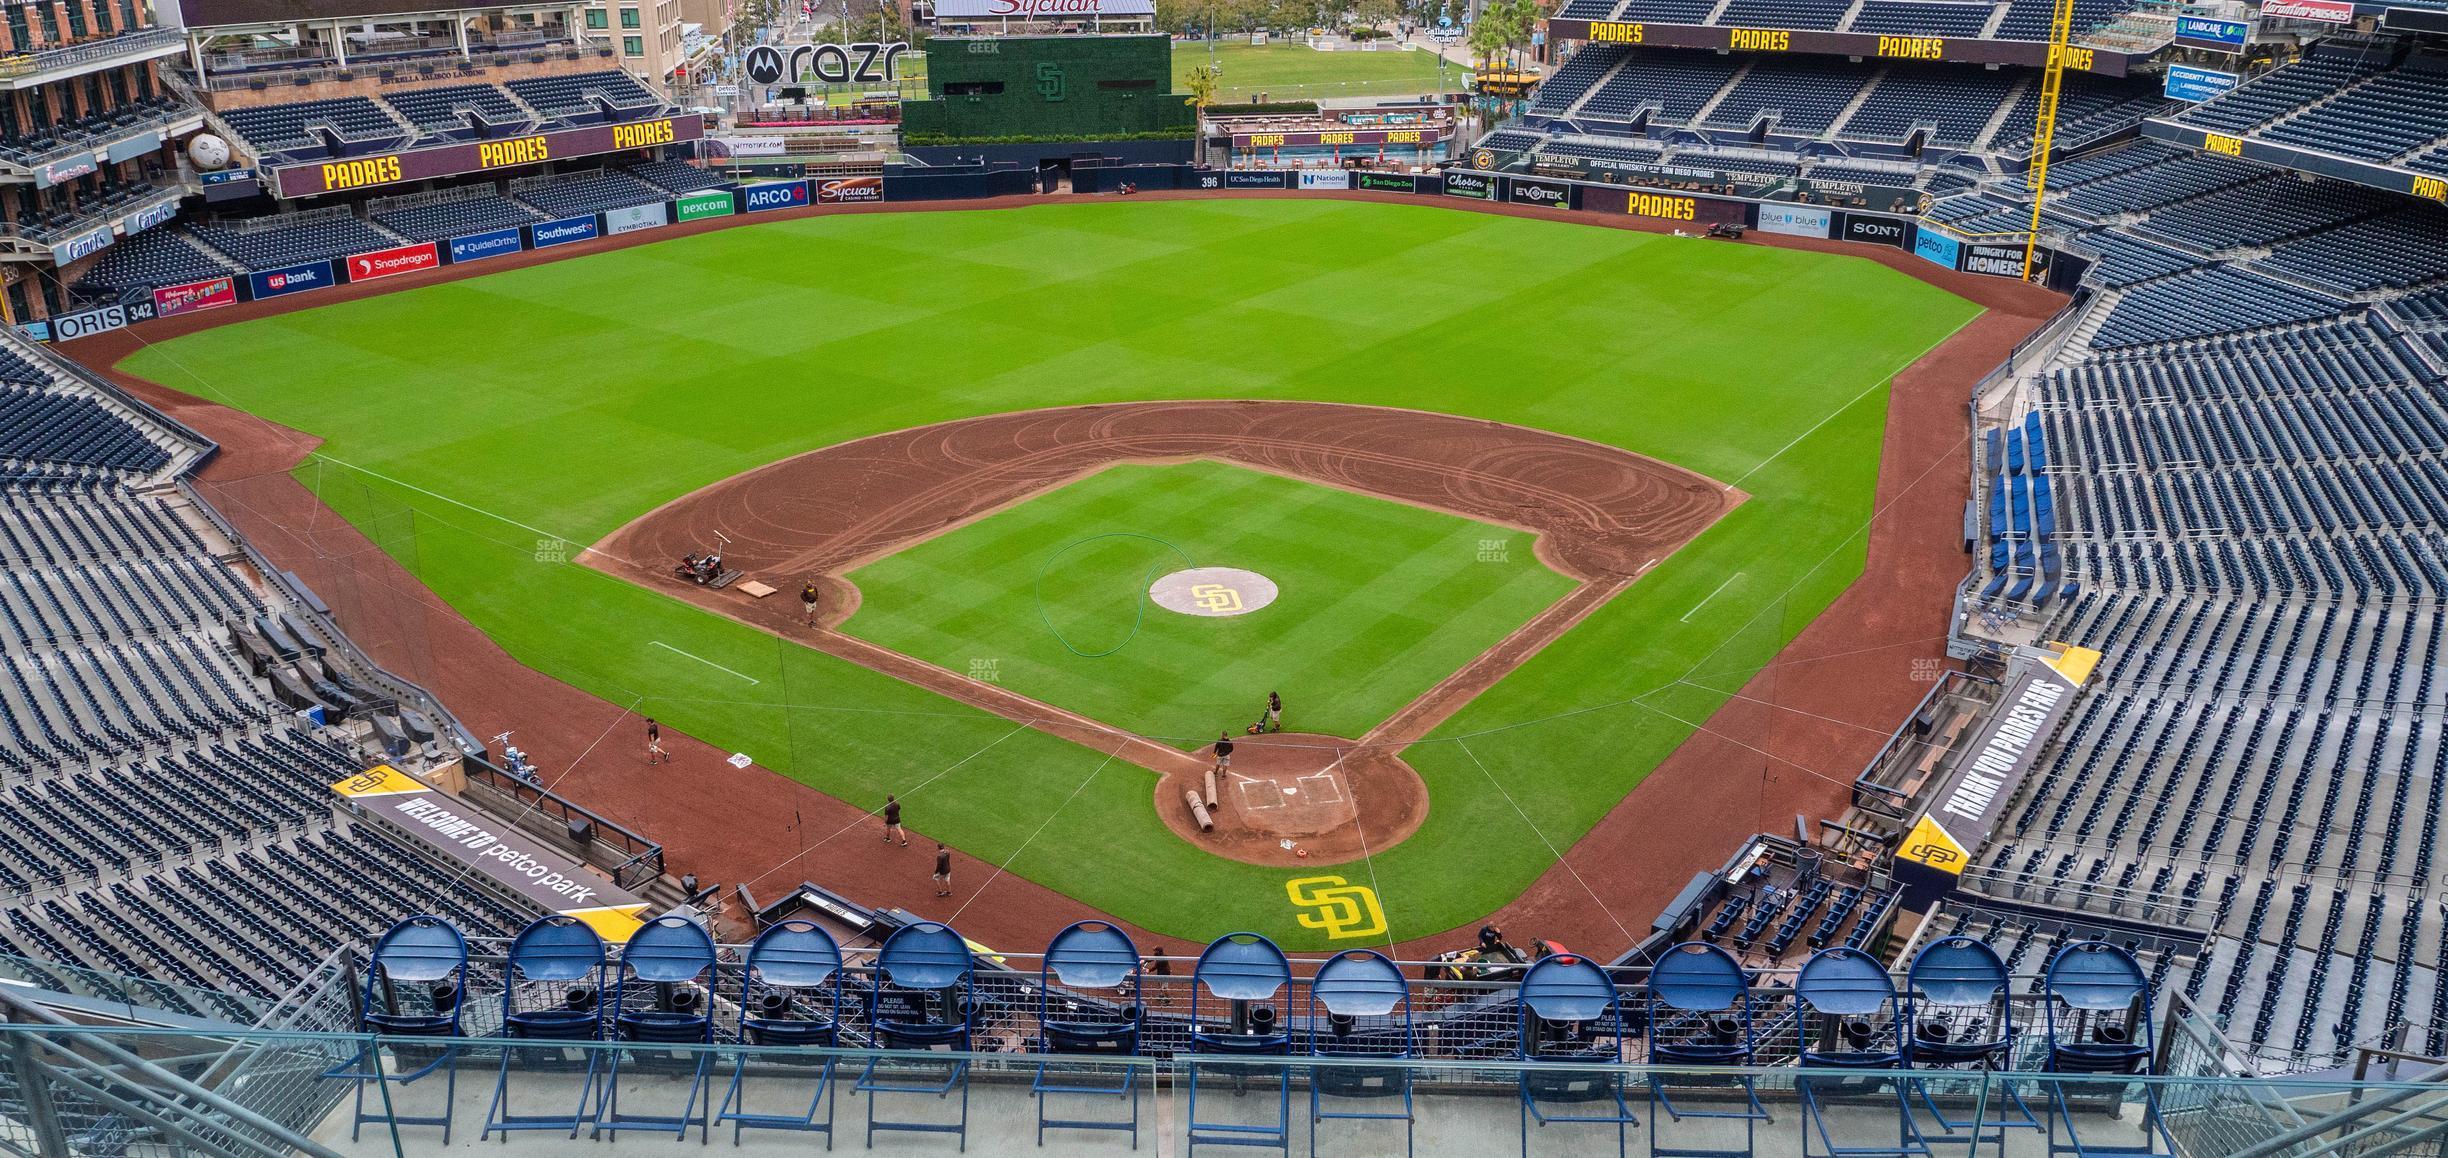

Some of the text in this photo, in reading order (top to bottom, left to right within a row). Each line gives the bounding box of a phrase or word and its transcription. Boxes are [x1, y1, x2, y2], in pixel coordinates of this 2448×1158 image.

[2263, 0, 2350, 21] Tarantino SAUSAGES
[1424, 27, 1463, 38] Gallagher
[1590, 21, 1643, 43] PADRES
[2188, 20, 2224, 38] LANDCARE
[1429, 35, 1457, 43] Square
[1730, 28, 1790, 51] PADRES
[1877, 36, 1943, 59] PADRES
[788, 42, 909, 84] razr
[2048, 44, 2094, 71] PDRES
[611, 119, 674, 149] PADRES
[1250, 134, 1285, 146] PADRES
[1320, 133, 1354, 144] PADRES
[1387, 131, 1421, 142] PADRES
[479, 136, 549, 168] PADRES
[2204, 133, 2242, 155] PADRES
[1534, 154, 1579, 166] TEMPLETON
[322, 155, 402, 190] PADRES
[1316, 174, 1346, 182] National
[1590, 160, 1617, 169] OFFICIAL
[1618, 163, 1647, 172] WHISKEY
[1661, 167, 1674, 175] SAN
[1674, 168, 1692, 176] DIEGO
[1692, 170, 1715, 179] PADRES
[1725, 172, 1777, 185] TEMPLETON
[1202, 176, 1218, 188] 396
[1386, 180, 1402, 188] Diego
[1447, 174, 1485, 188] Chosen
[1810, 180, 1864, 194] TEMPLETON
[749, 188, 791, 206] ARCO
[821, 180, 878, 202] Sycuan
[1515, 187, 1563, 201] EVOTEK
[1627, 192, 1696, 221] PADRES
[137, 205, 169, 231] Canel's
[1761, 212, 1783, 222] blue
[1795, 216, 1817, 226] blue
[537, 223, 586, 241] Southwest
[1853, 223, 1901, 237] SONY
[68, 231, 105, 261] Canel's
[467, 235, 518, 252] QuidelOrtho
[1917, 234, 1943, 254] petco
[1973, 246, 2023, 259] HUNGRY FOR
[374, 252, 433, 271] Snapdragon
[1967, 256, 2025, 277] HOMERS
[285, 270, 316, 284] bank
[130, 303, 153, 320] 342
[60, 309, 123, 337] ORIS
[1943, 678, 2065, 822] THANK YOU PADRES FANS
[394, 797, 597, 903] WELCOME TO petco park
[1285, 875, 1387, 940] SD
